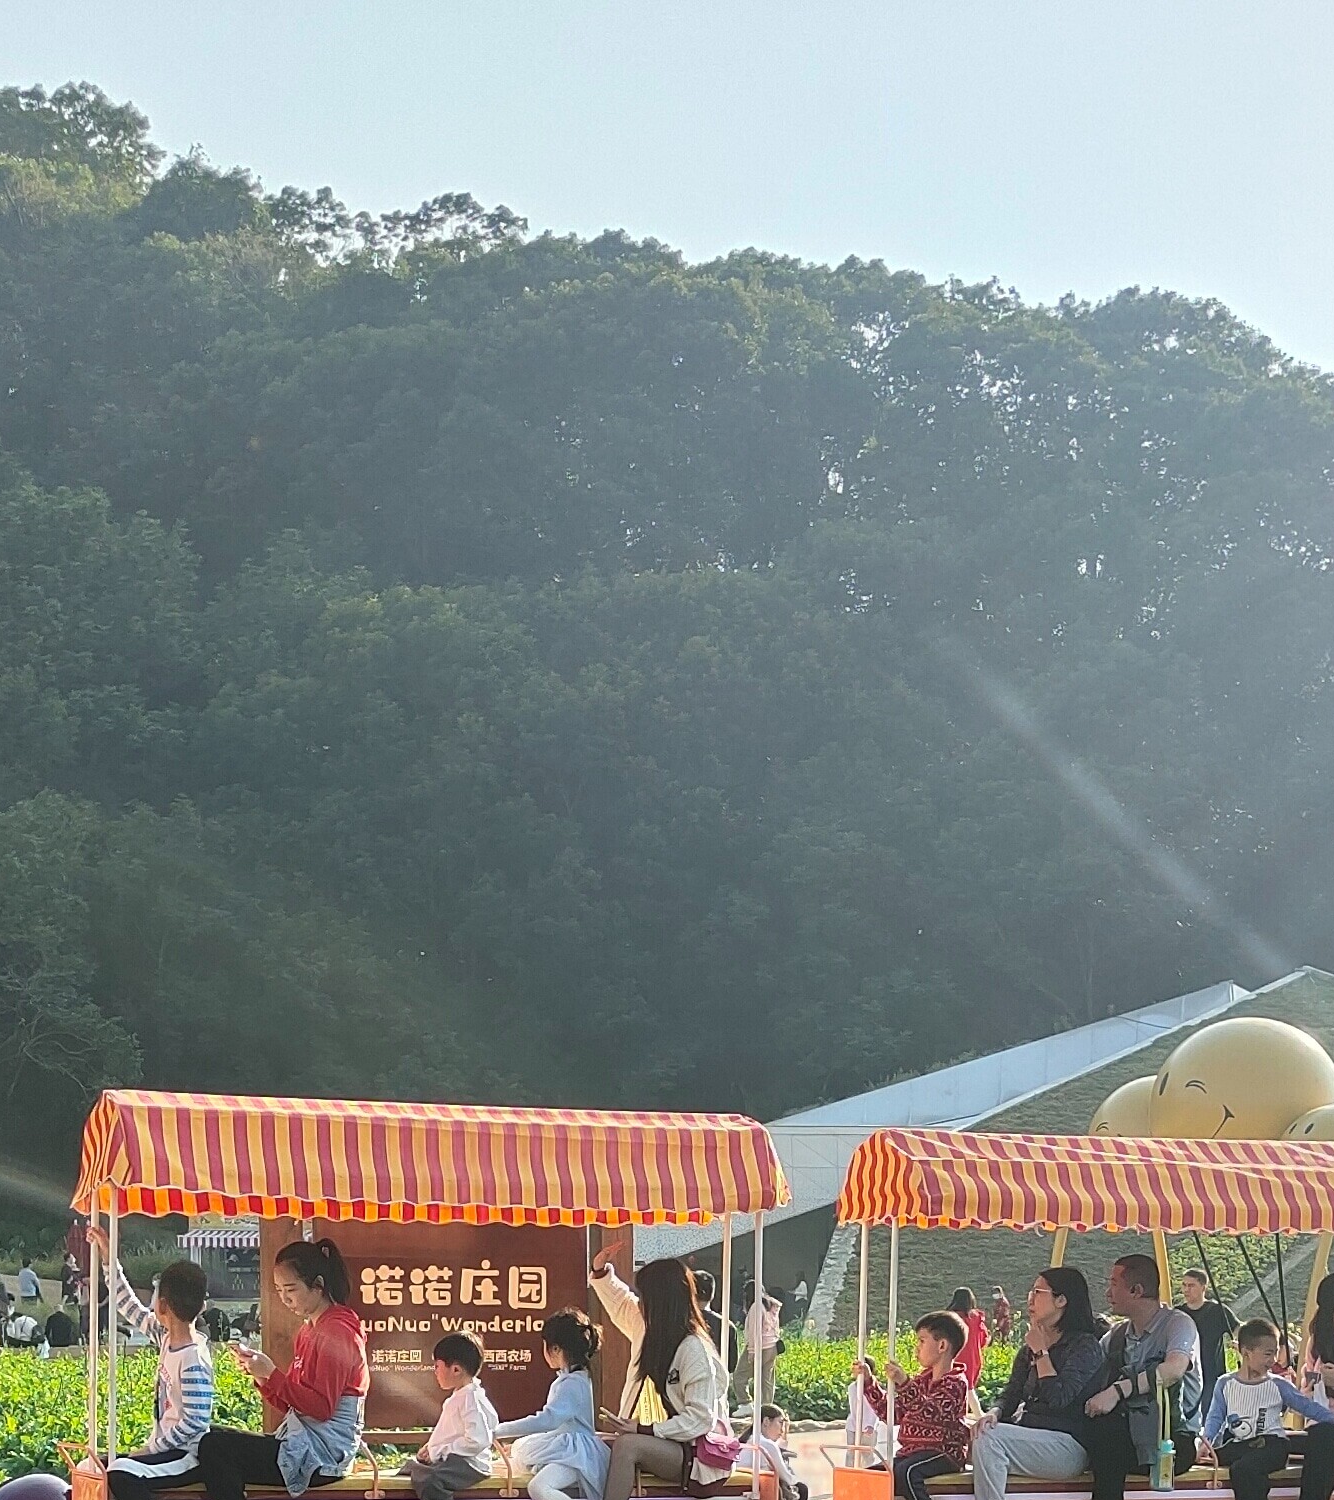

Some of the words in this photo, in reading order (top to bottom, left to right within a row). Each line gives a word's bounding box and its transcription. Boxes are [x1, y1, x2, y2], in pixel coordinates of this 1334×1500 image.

[359, 1259, 547, 1310] 诺诺庄园
[360, 1313, 439, 1333] uoNuo"
[440, 1314, 544, 1334] Wonderla
[371, 1349, 422, 1363] 诺诺庄园
[482, 1349, 532, 1363] 西西农场
